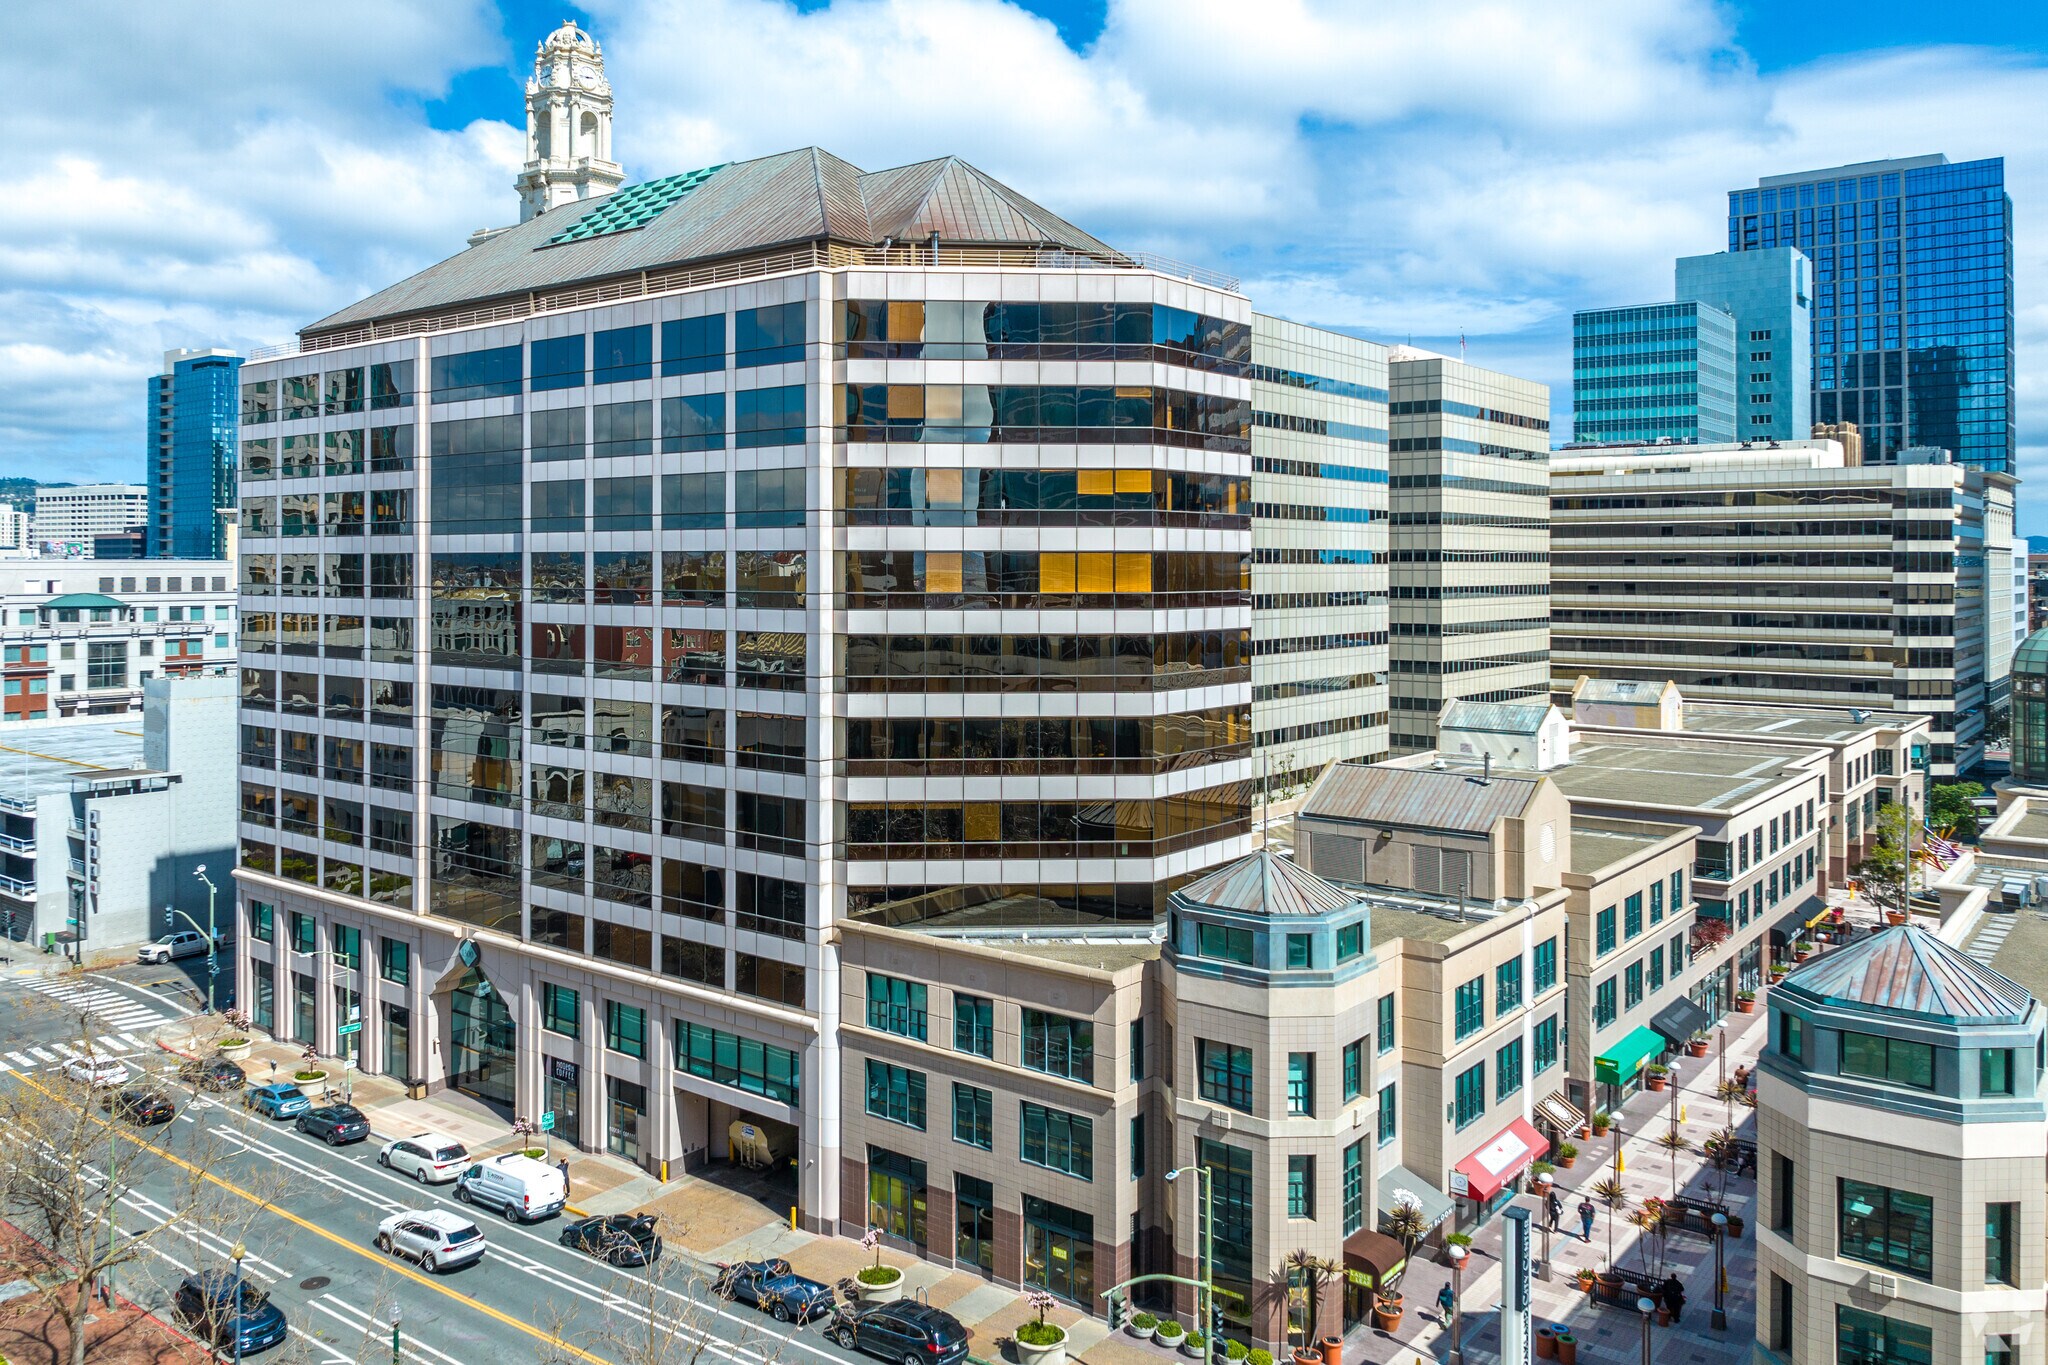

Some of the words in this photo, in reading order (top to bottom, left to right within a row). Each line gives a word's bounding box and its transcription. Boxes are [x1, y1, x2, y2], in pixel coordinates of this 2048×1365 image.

[556, 1060, 575, 1073] MODERN
[556, 1068, 574, 1080] COFFEE
[1434, 1207, 1453, 1226] BLOOM
[1522, 1219, 1530, 1271] CENTER
[1351, 1270, 1371, 1280] LADLE
[1355, 1277, 1370, 1285] LEAF
